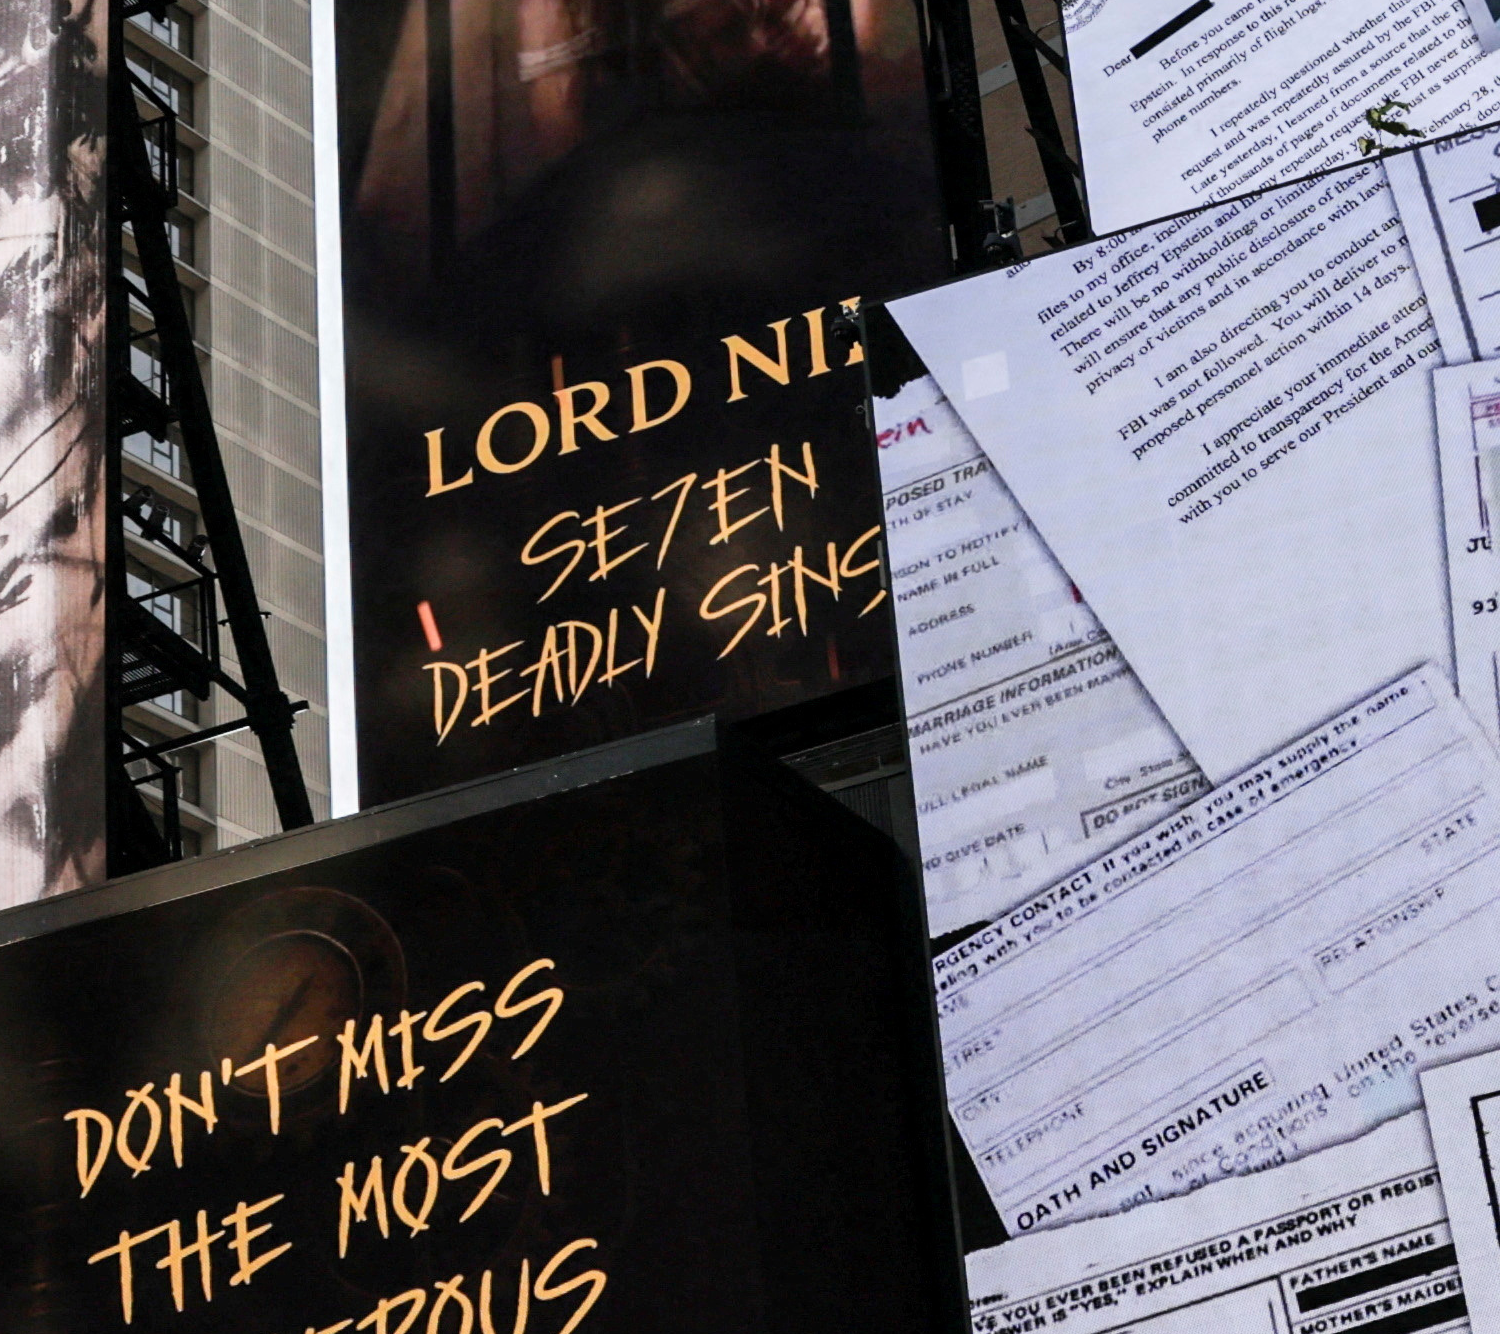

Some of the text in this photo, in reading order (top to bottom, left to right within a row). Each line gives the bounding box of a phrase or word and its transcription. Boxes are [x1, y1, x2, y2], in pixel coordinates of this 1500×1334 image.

[1103, 53, 1133, 78] Dear
[424, 296, 864, 498] LORD NI
[1179, 357, 1416, 524] with you to serve our President and
[520, 441, 821, 605] SE7EN
[422, 587, 667, 747] DEADLY
[998, 646, 1120, 704] INFORMATION
[62, 955, 568, 1201] DON'T MISS
[1016, 1068, 1271, 1229] OATH AND SIGNATURE
[86, 1092, 591, 1326] THE MOST
[1044, 1206, 1342, 1309] EVER BEEN REFUSED PASSPORT
[1380, 1230, 1438, 1258] NAME
